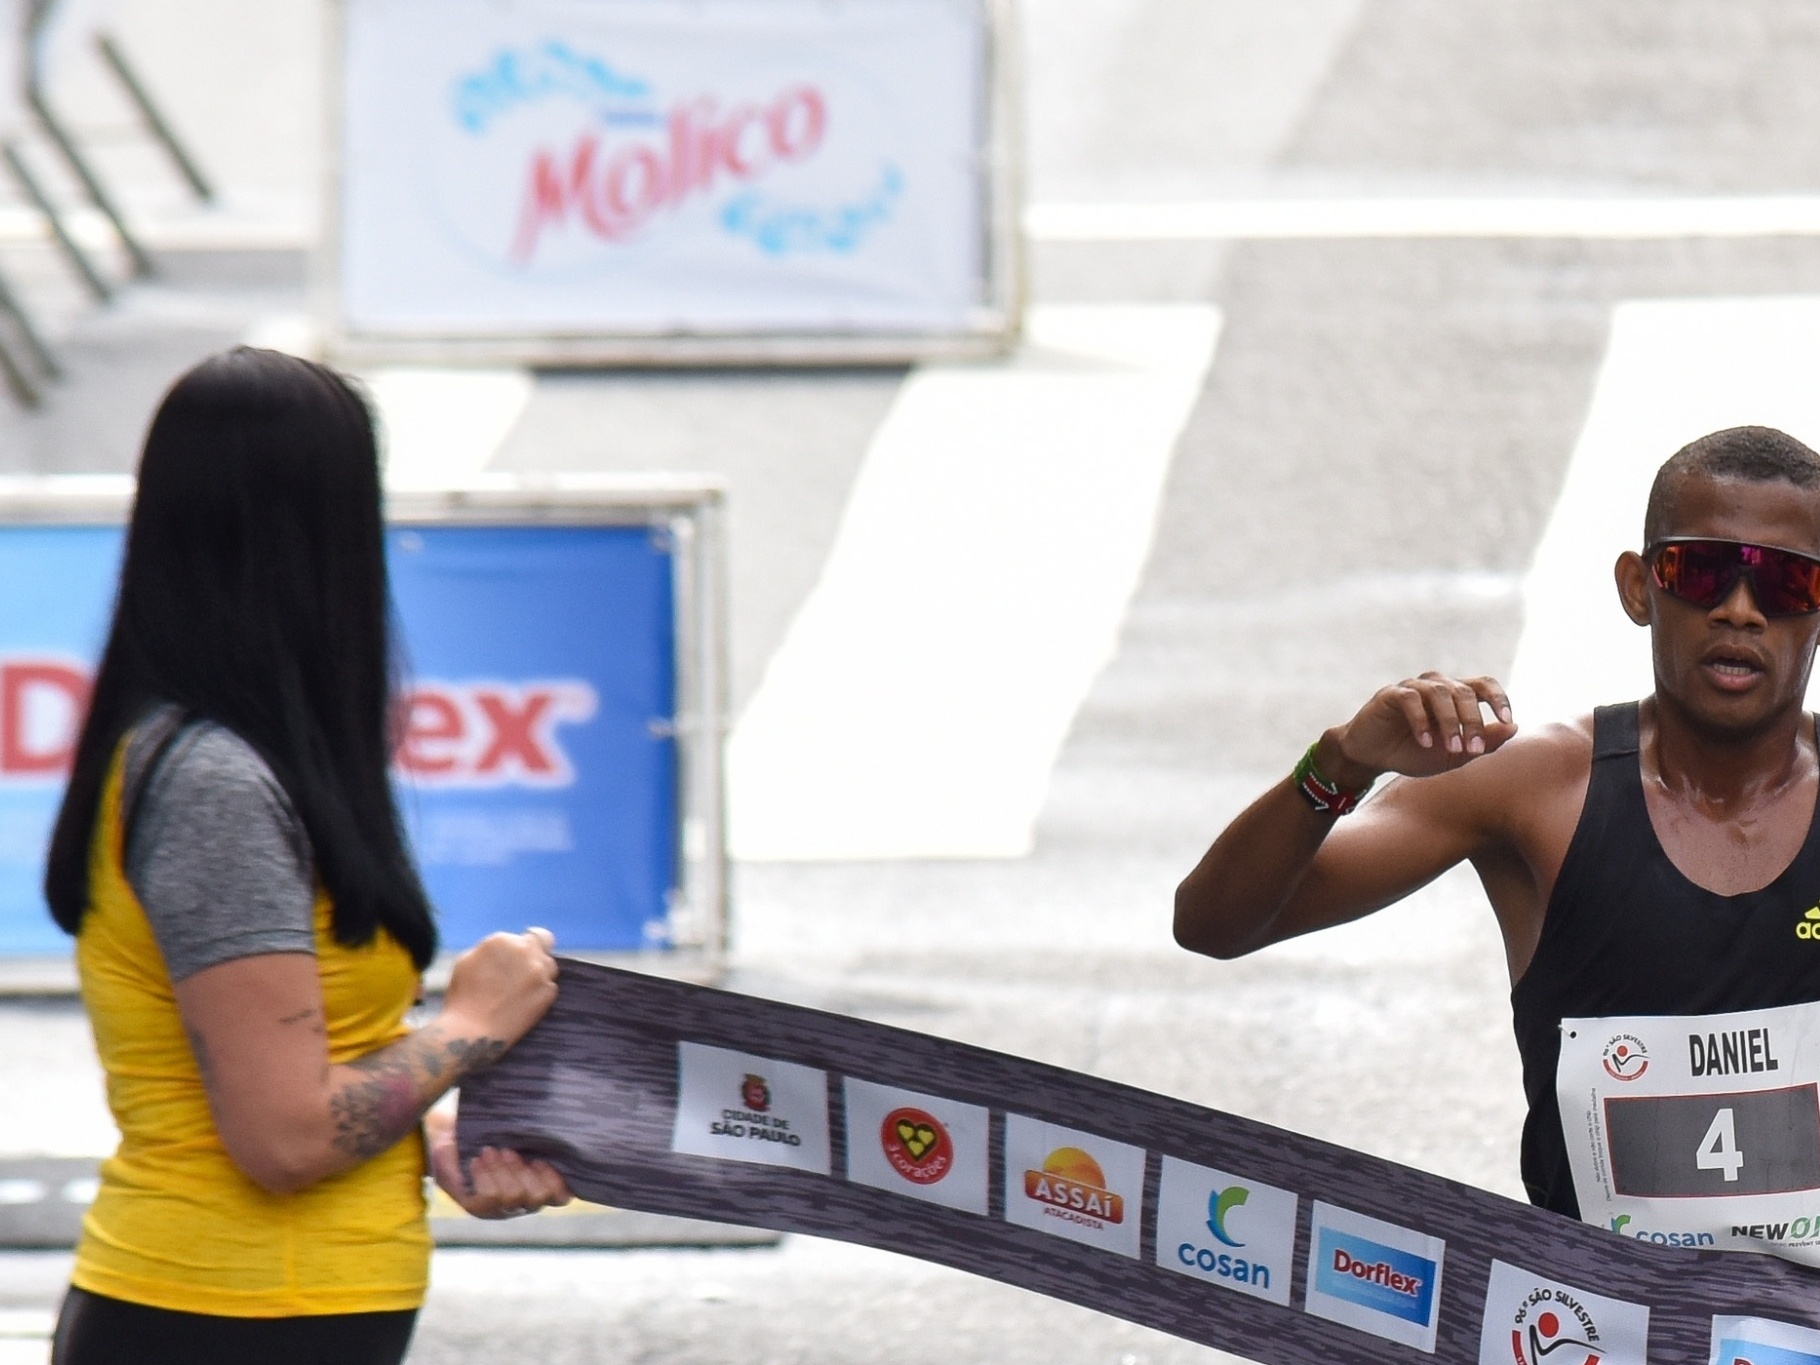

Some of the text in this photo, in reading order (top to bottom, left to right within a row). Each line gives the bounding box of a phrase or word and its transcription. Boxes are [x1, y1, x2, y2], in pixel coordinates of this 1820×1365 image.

[511, 84, 827, 267] Molico
[1688, 1028, 1779, 1077] DANIEL
[710, 1120, 802, 1147] SÃO PAULO
[723, 1109, 790, 1130] CIDADE DE
[1696, 1108, 1744, 1182] 4
[1044, 1207, 1104, 1229] ATACADISTA
[1178, 1243, 1270, 1290] cosan
[1333, 1248, 1420, 1296] Dorflex
[1528, 1287, 1552, 1307] SÃO
[1554, 1290, 1600, 1342] SILVESTRE
